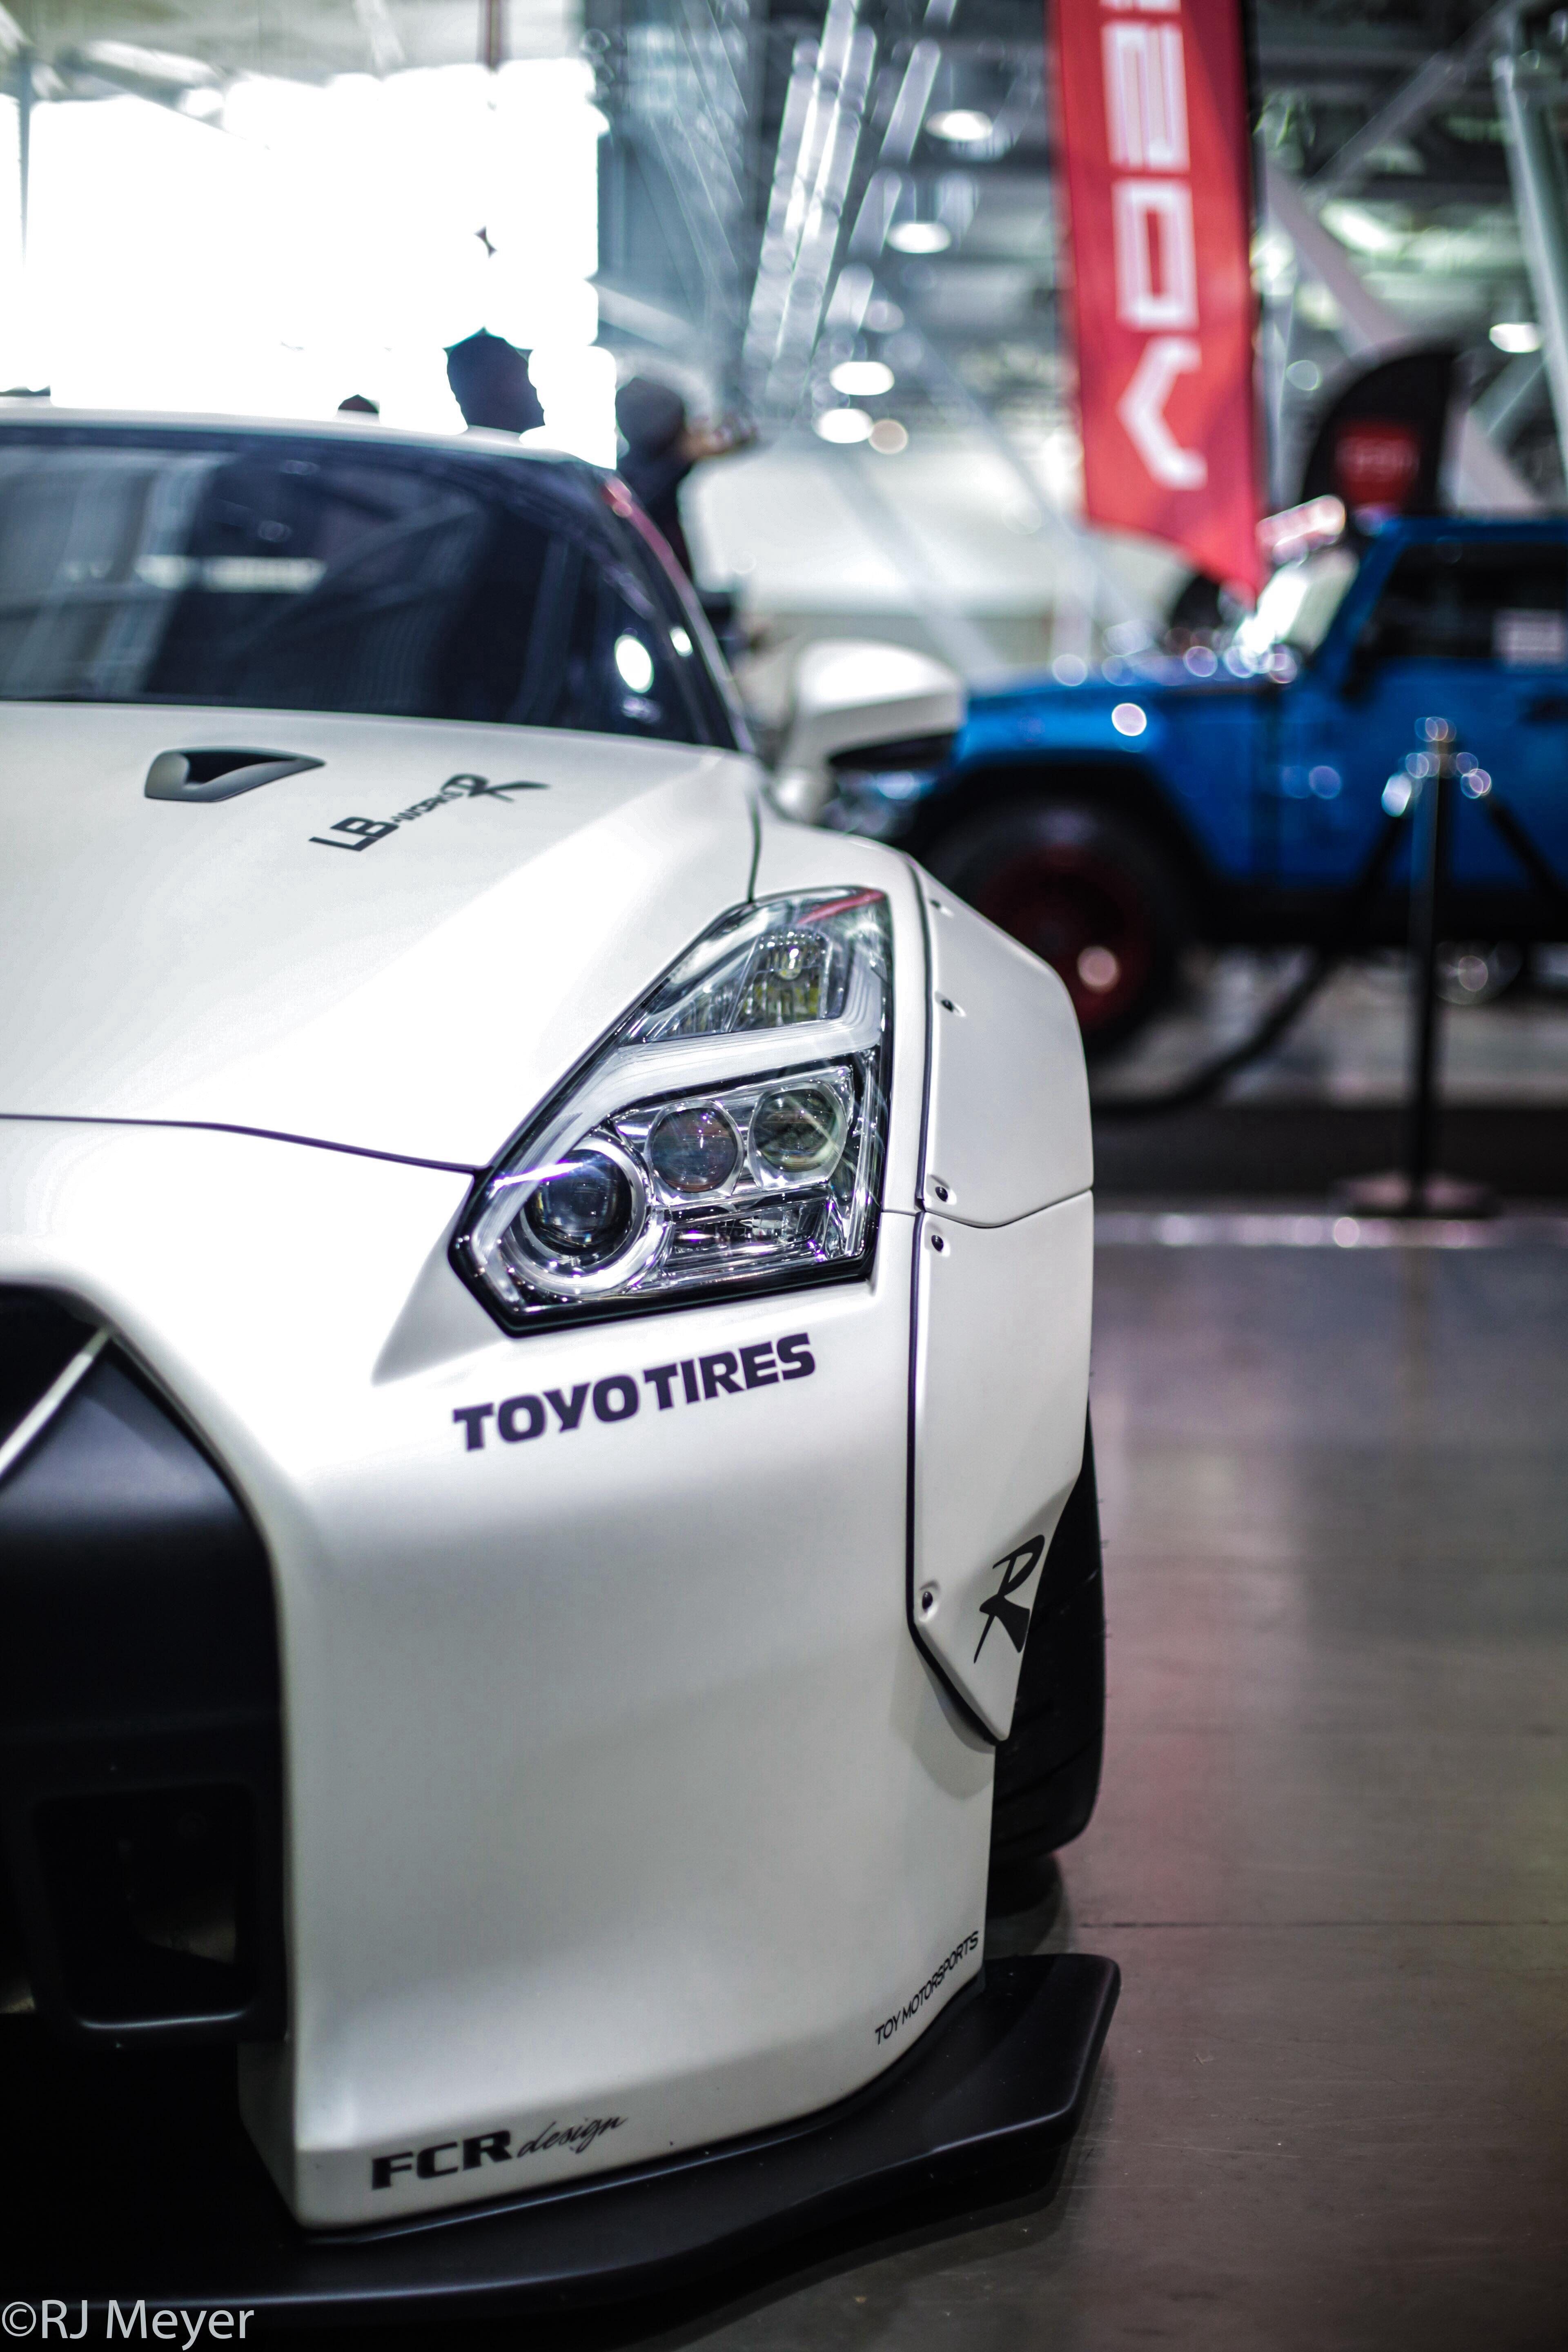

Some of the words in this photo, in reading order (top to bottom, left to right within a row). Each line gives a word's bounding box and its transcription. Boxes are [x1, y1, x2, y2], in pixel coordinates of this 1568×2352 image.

[453, 1374, 640, 1452] TOYO
[643, 1332, 816, 1410] TIRES
[973, 1535, 1045, 1664] R
[875, 2011, 901, 2045] TOY
[902, 1930, 979, 2025] MOTORSPORTS
[372, 2130, 512, 2190] FCR
[517, 2117, 628, 2154] design
